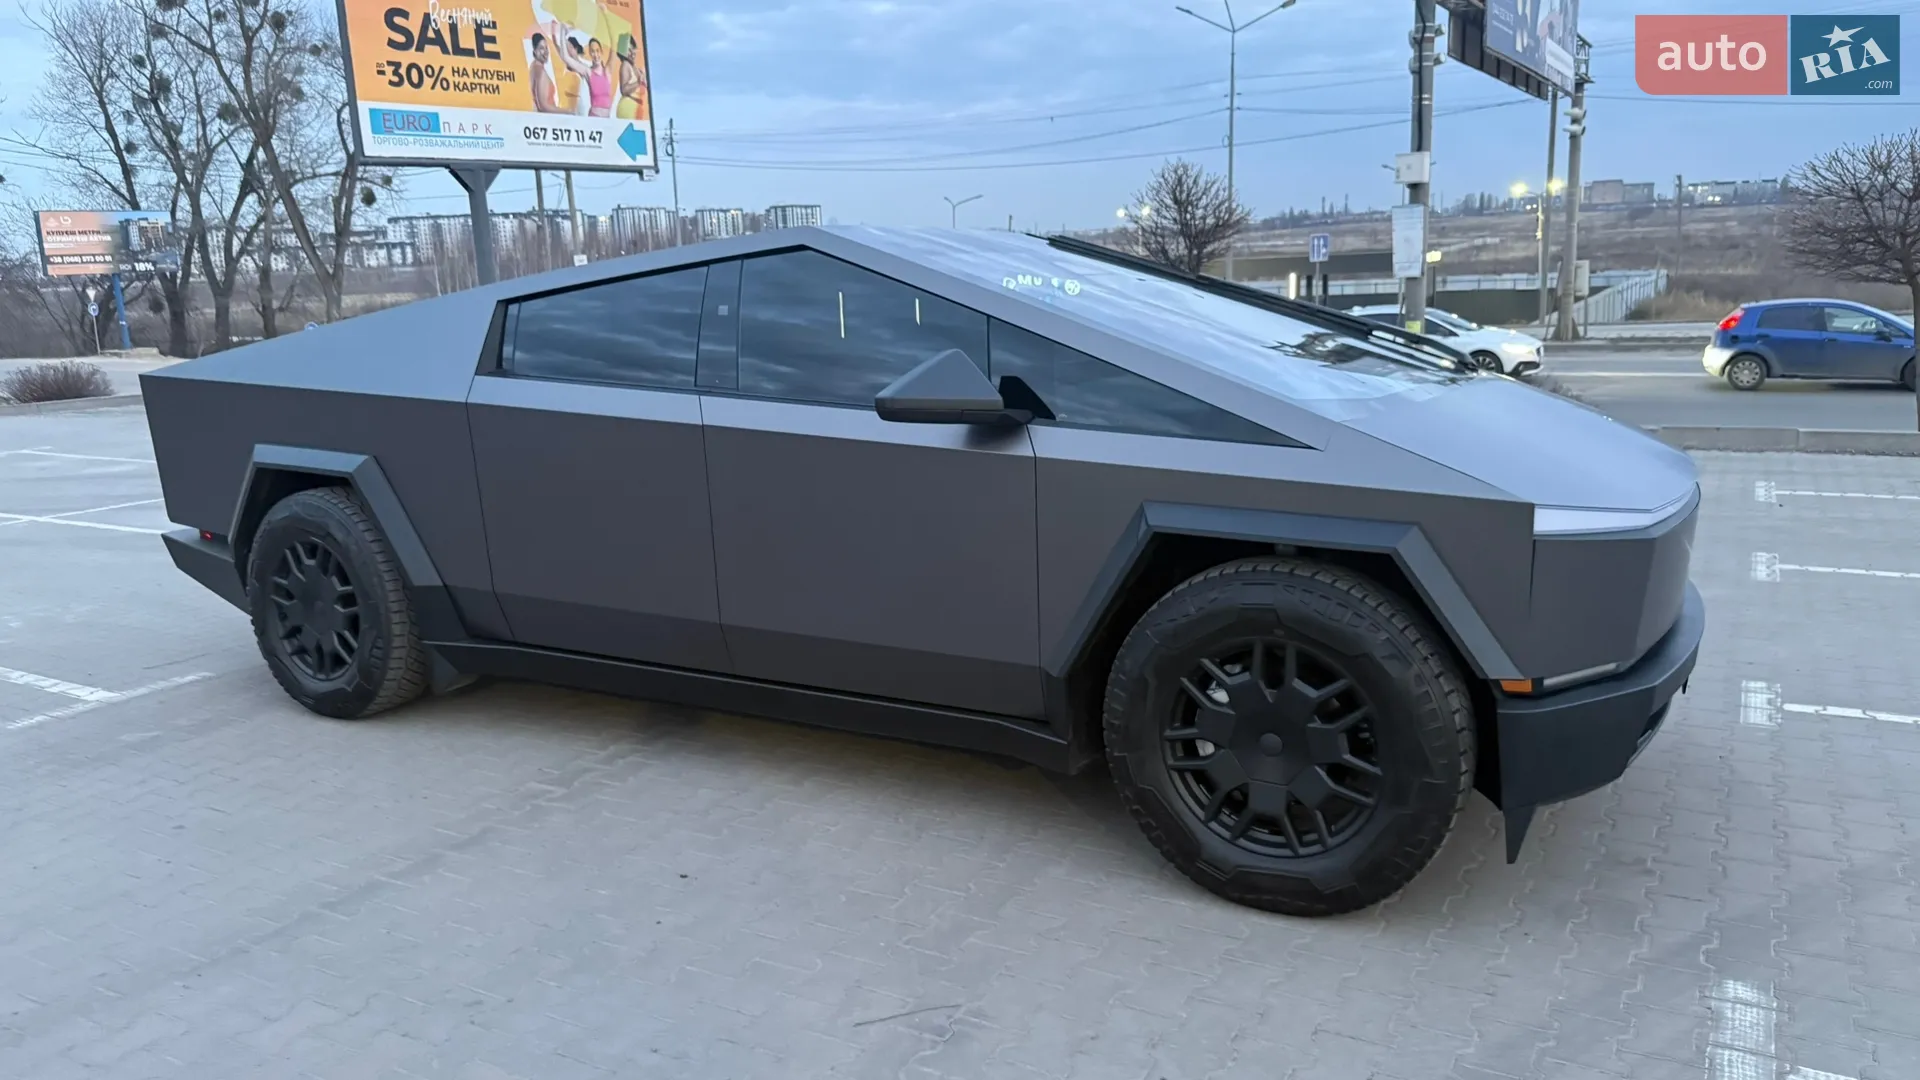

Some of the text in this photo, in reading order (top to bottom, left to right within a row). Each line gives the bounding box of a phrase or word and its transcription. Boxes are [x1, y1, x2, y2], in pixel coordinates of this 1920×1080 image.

[429, 1, 493, 30] Весняний
[383, 7, 501, 60] SALE
[376, 60, 450, 91] -30%
[451, 66, 515, 83] НА КЛУБНІ
[452, 80, 501, 95] КАРТКИ
[382, 112, 431, 132] EURO
[372, 136, 505, 150] ТОРГОВО-РОЗВАЖАЛЬНИЙ ЦЕНТР
[523, 126, 603, 144] 067 517 11 47
[133, 261, 155, 272] 18%
